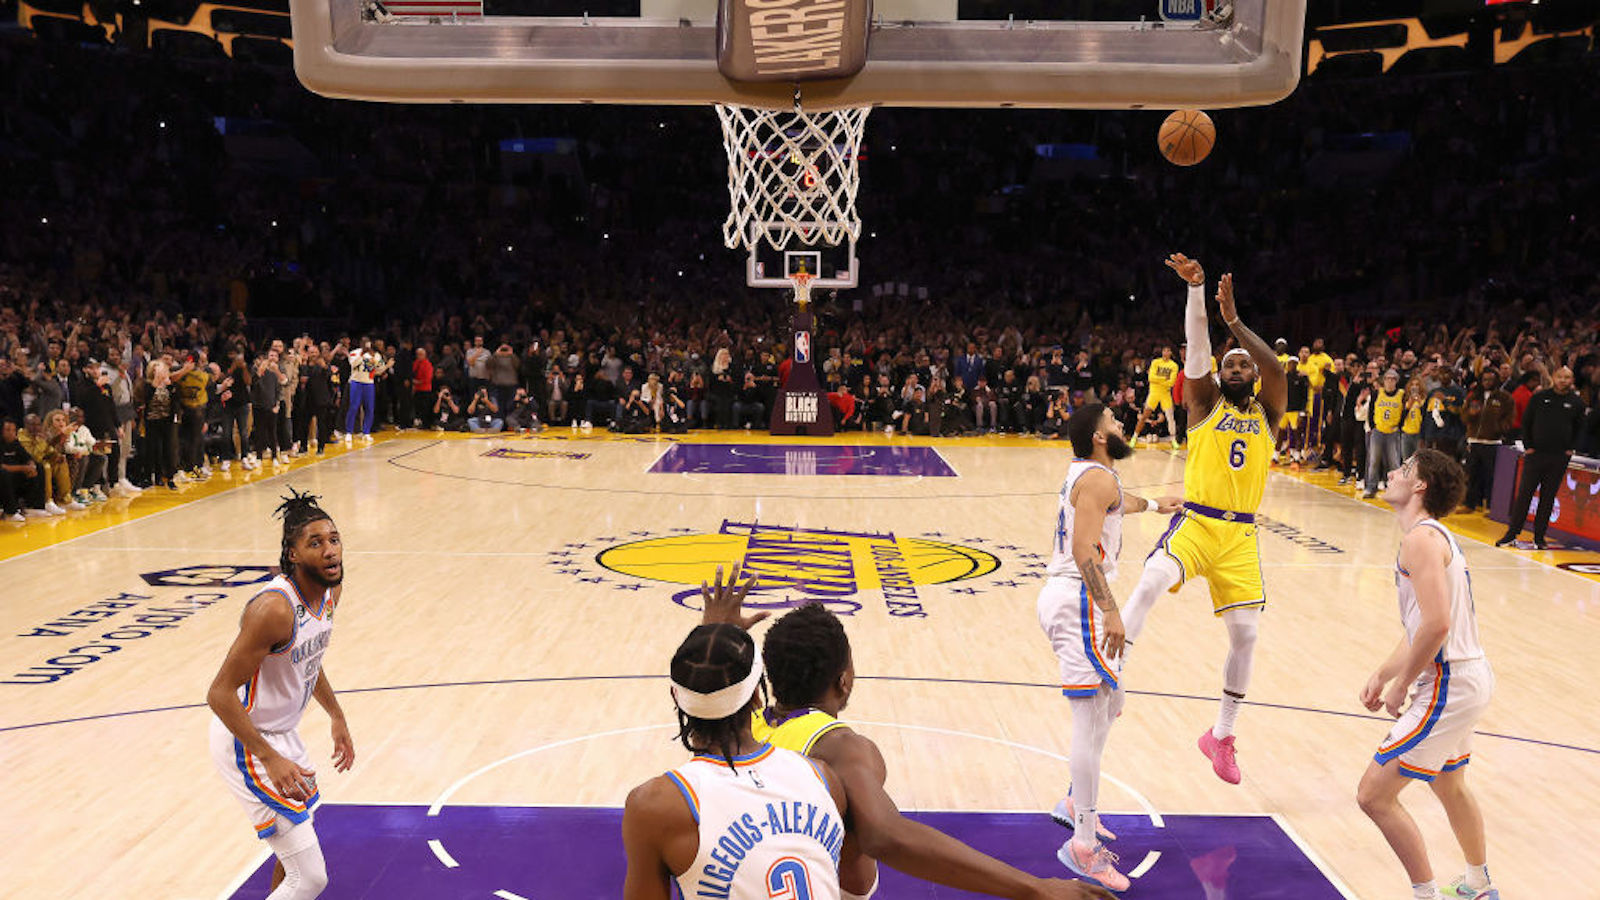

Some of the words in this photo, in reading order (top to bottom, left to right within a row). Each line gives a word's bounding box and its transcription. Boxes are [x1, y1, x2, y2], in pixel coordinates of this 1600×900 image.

[1168, 0, 1195, 13] NBA
[785, 396, 818, 411] BLACK
[785, 411, 818, 423] HISTORY
[1214, 412, 1261, 435] LAKERS
[1228, 439, 1248, 471] 6
[17, 592, 153, 638] ARENA
